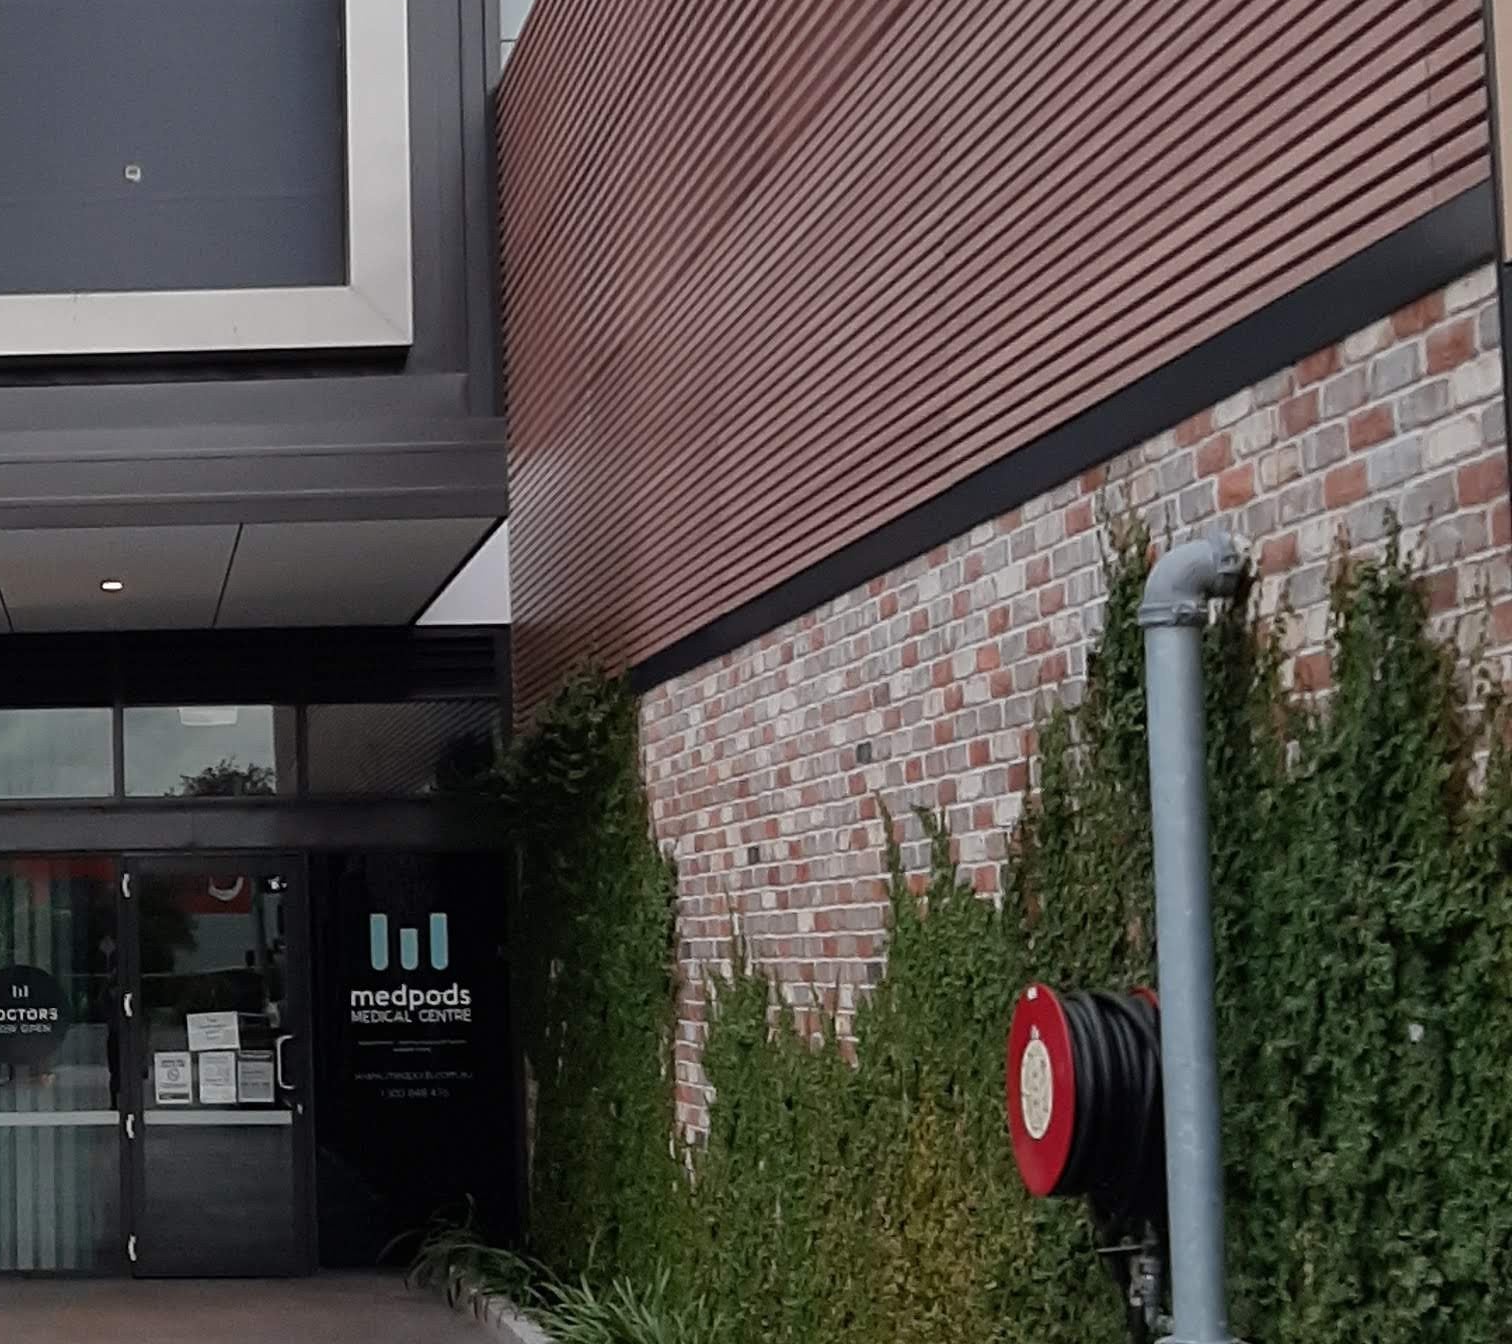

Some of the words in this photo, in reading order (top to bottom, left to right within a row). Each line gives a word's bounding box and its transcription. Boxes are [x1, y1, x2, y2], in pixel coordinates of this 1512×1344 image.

[350, 981, 472, 1012] medpods
[350, 1008, 413, 1024] MEDICAL
[418, 1007, 473, 1023] CENTRE
